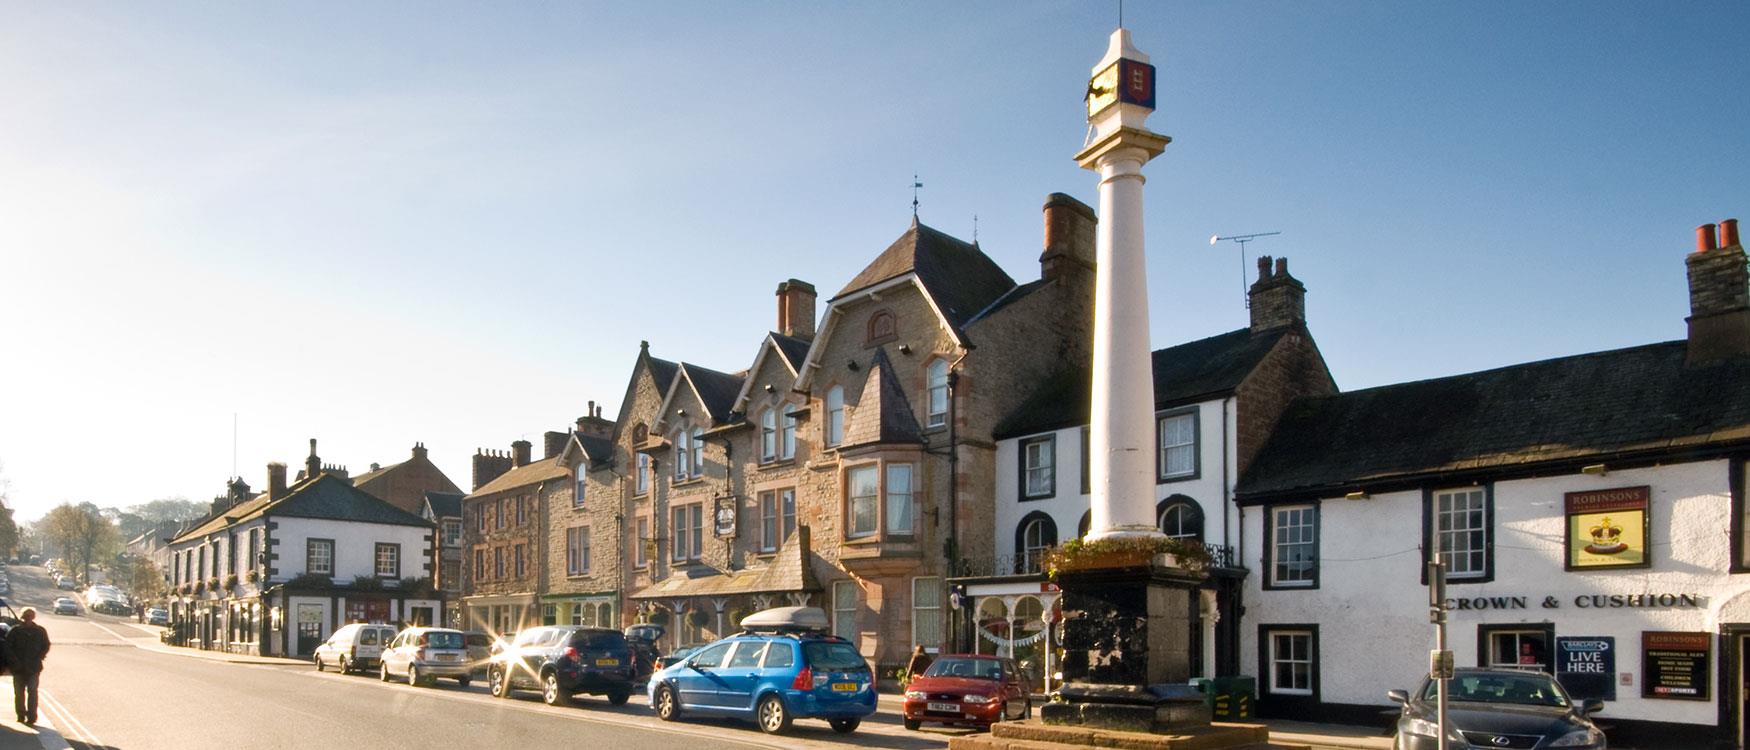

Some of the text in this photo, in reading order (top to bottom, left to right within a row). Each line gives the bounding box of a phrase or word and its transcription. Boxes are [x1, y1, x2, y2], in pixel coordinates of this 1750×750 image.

[1573, 491, 1640, 505] ROBINSONS
[1445, 593, 1699, 611] CROWN & CUSHION
[1570, 652, 1602, 662] LIVE
[1567, 662, 1605, 673] HERE
